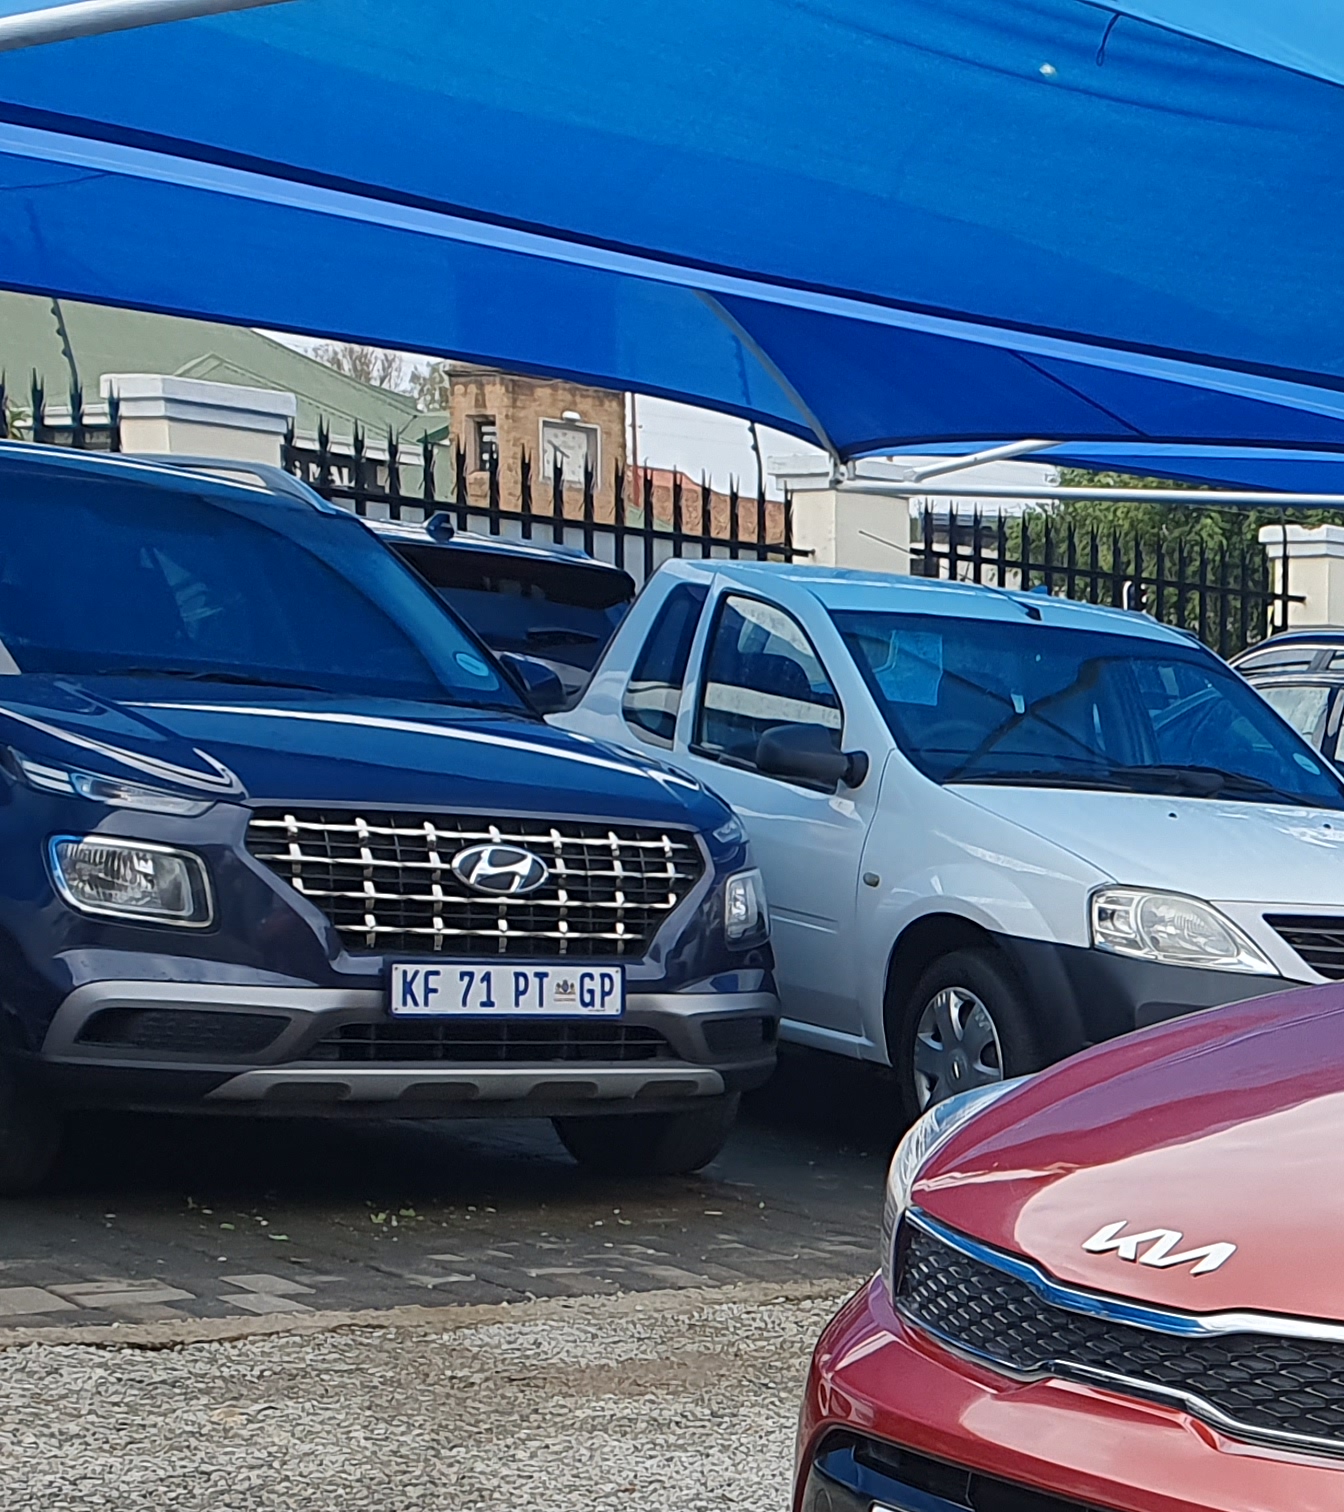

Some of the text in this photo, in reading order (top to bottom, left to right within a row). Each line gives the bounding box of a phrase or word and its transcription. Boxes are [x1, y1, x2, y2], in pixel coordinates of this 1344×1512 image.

[401, 970, 614, 1009] KF 71 PT GP
